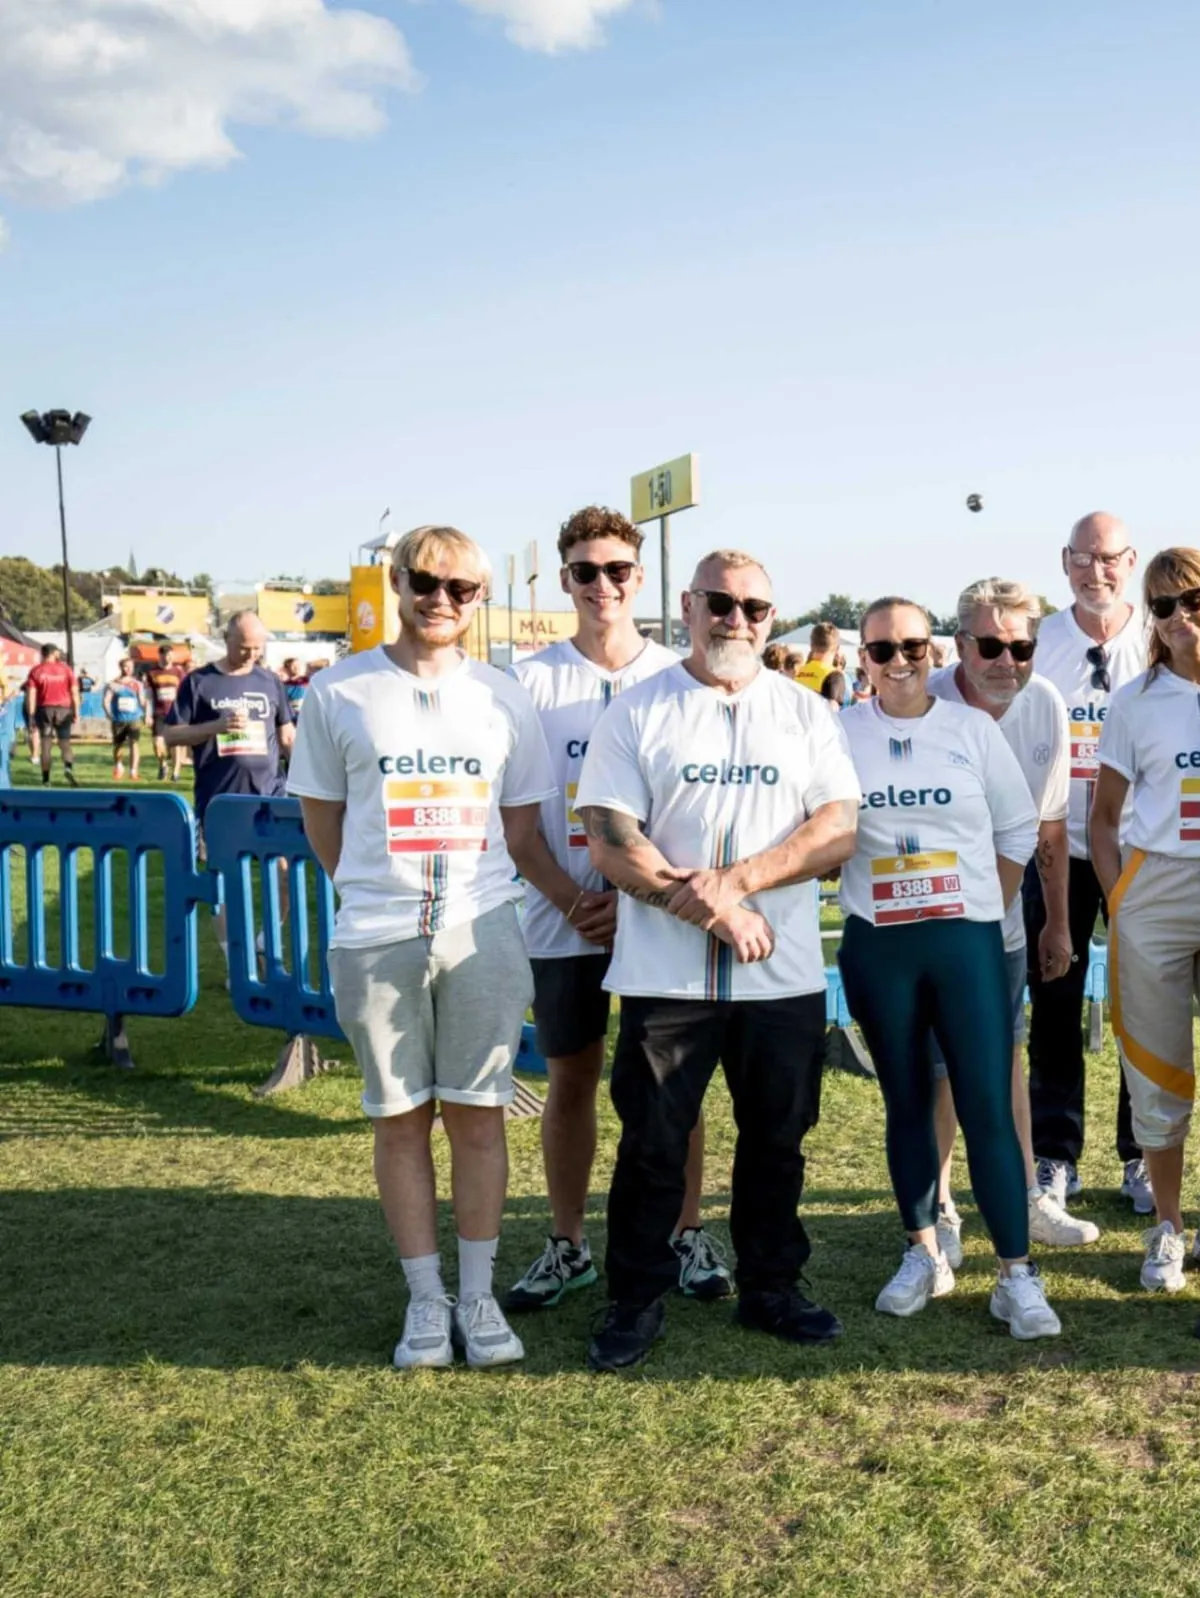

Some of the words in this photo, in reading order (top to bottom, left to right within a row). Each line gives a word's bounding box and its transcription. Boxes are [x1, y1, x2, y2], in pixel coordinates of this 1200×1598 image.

[519, 619, 559, 635] MAL
[378, 748, 482, 775] celero
[682, 758, 780, 785] celero
[892, 878, 934, 898] 8388
